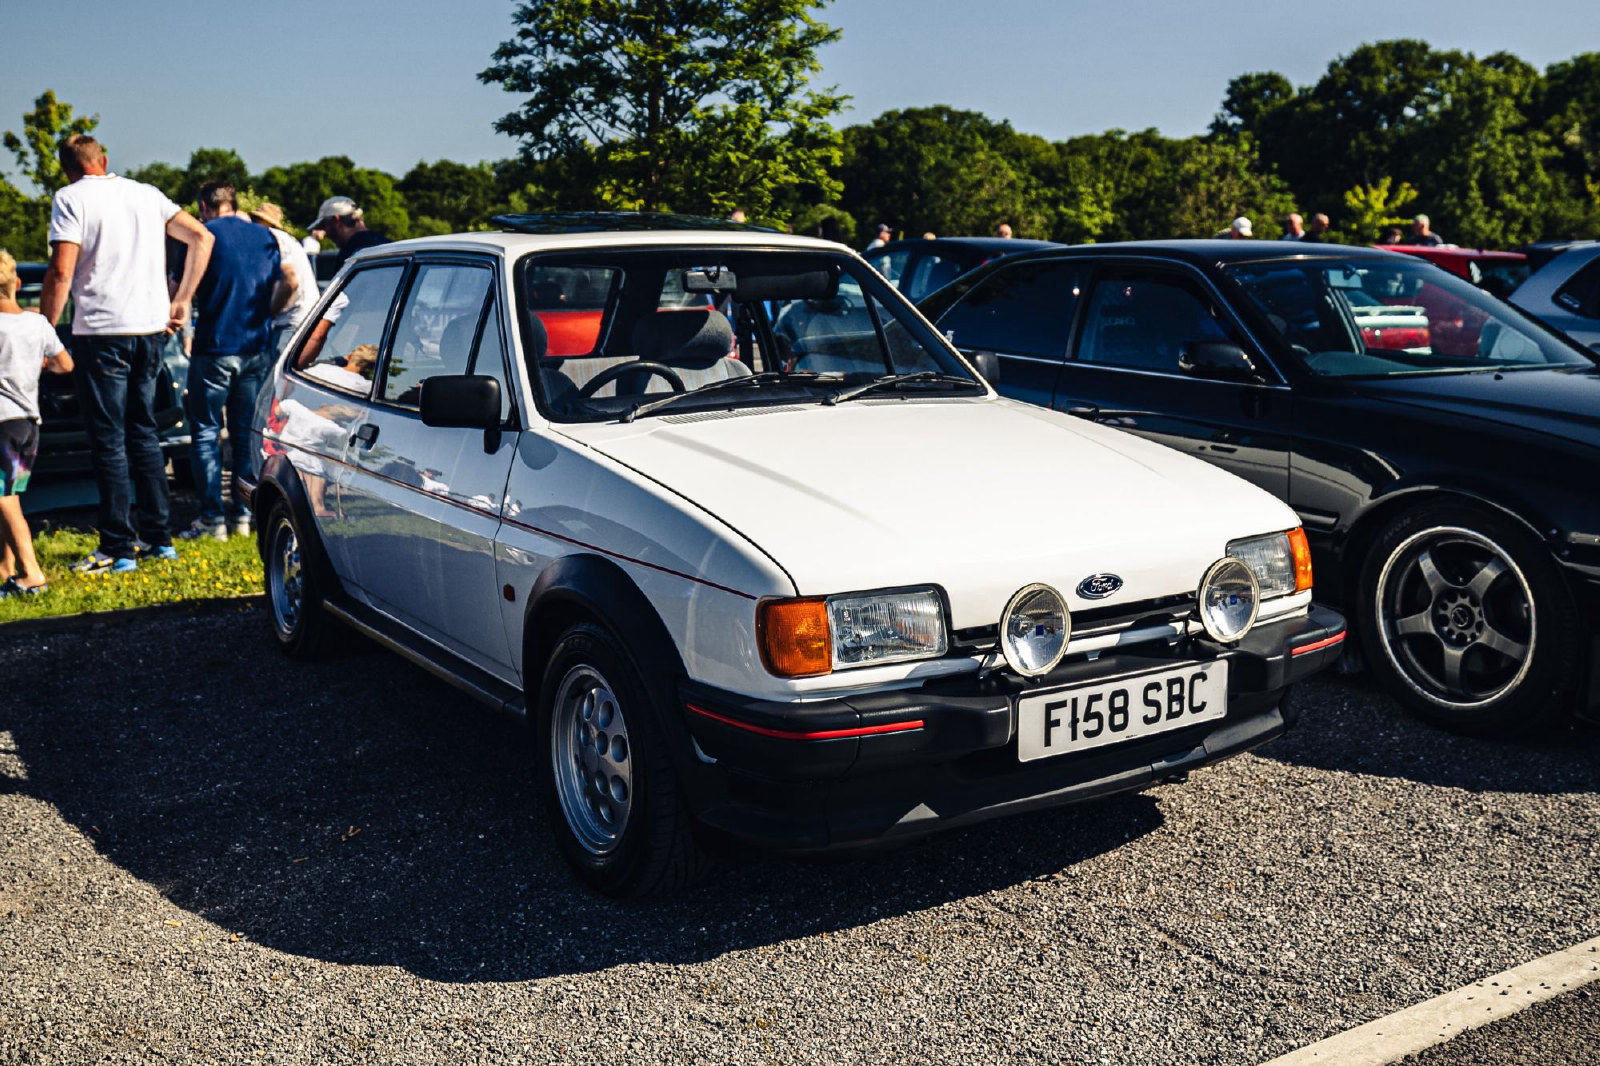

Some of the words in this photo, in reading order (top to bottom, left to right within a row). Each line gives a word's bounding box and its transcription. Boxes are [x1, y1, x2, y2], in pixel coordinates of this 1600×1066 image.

[1091, 577, 1114, 592] Ford
[1044, 688, 1130, 748] F158
[1142, 671, 1208, 726] SBC
